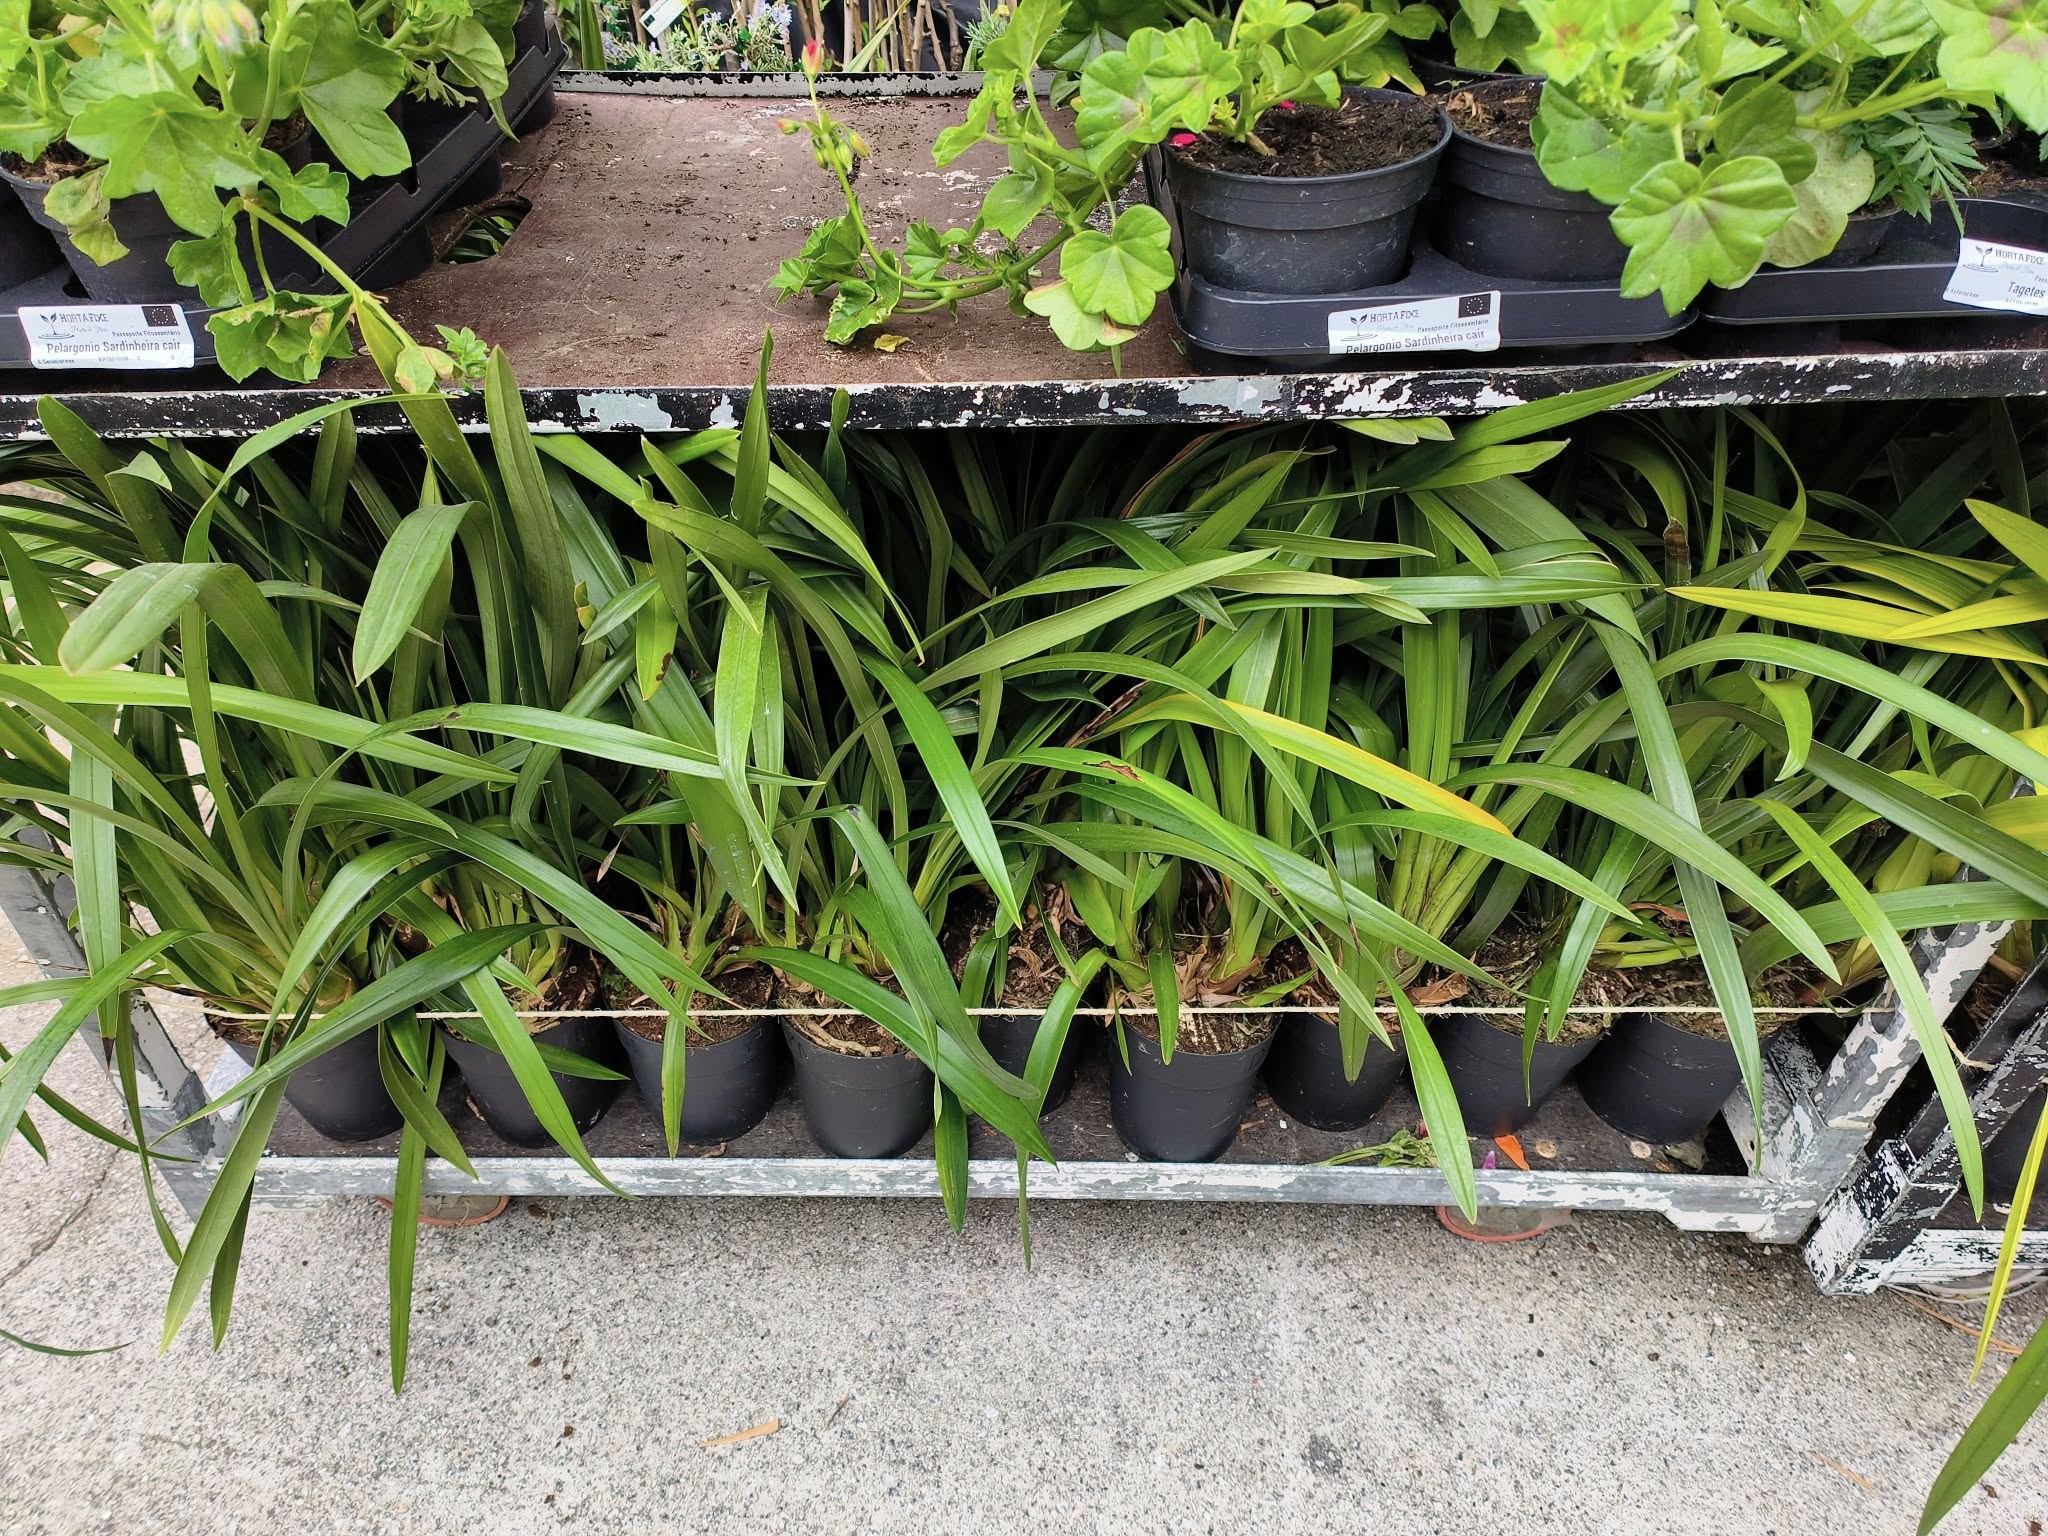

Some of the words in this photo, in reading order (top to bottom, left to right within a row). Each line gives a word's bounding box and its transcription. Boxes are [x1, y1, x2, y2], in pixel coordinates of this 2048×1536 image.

[2008, 281, 2046, 299] Tagetes
[47, 343, 101, 355] Pelargonio
[103, 340, 160, 352] Sardinheira
[162, 339, 181, 350] cair
[1346, 339, 1402, 354] Pelargonio
[1404, 332, 1463, 348] Sardinheira
[1466, 328, 1485, 340] cair
